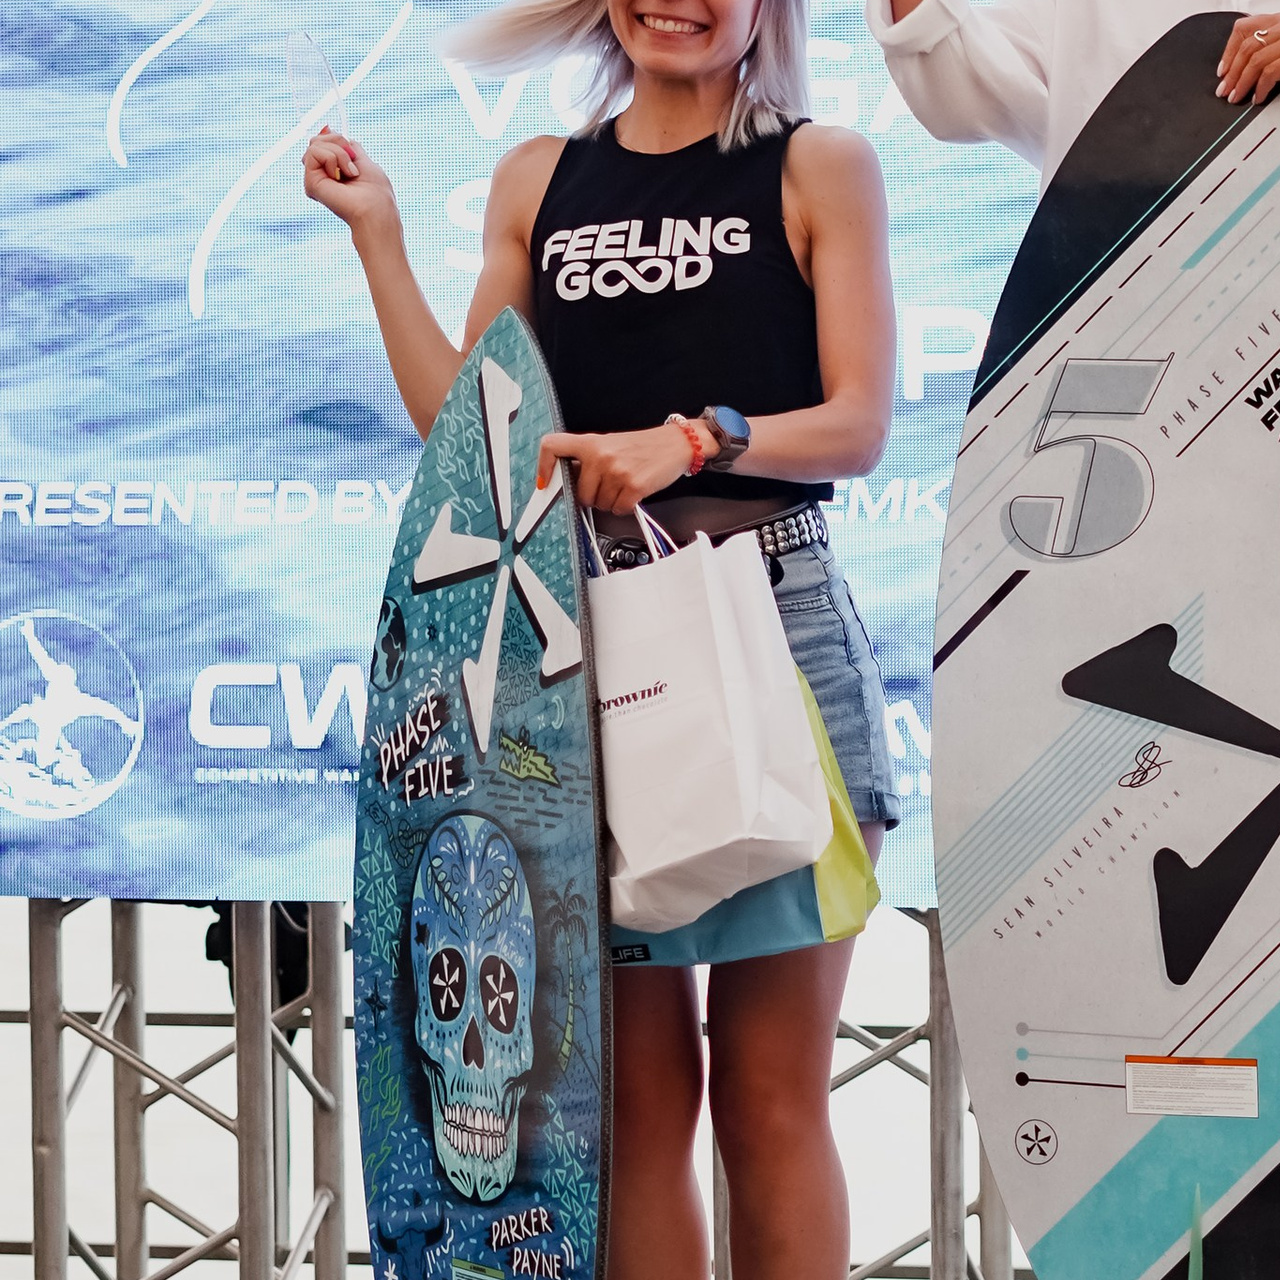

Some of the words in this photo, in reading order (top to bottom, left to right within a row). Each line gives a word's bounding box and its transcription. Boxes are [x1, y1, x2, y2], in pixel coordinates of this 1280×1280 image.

[542, 216, 751, 272] FEELING
[555, 255, 713, 302] GOOD
[1159, 370, 1225, 439] PHASE
[1001, 352, 1175, 564] 5
[332, 480, 413, 525] BY
[379, 687, 442, 791] PHASE
[403, 755, 454, 807] FIVE
[993, 895, 1036, 939] SEAN
[1043, 806, 1124, 888] SILVEIRA
[1034, 887, 1085, 938] WORLD
[1098, 789, 1181, 874] CHAMPION
[491, 1206, 553, 1253] PARKER
